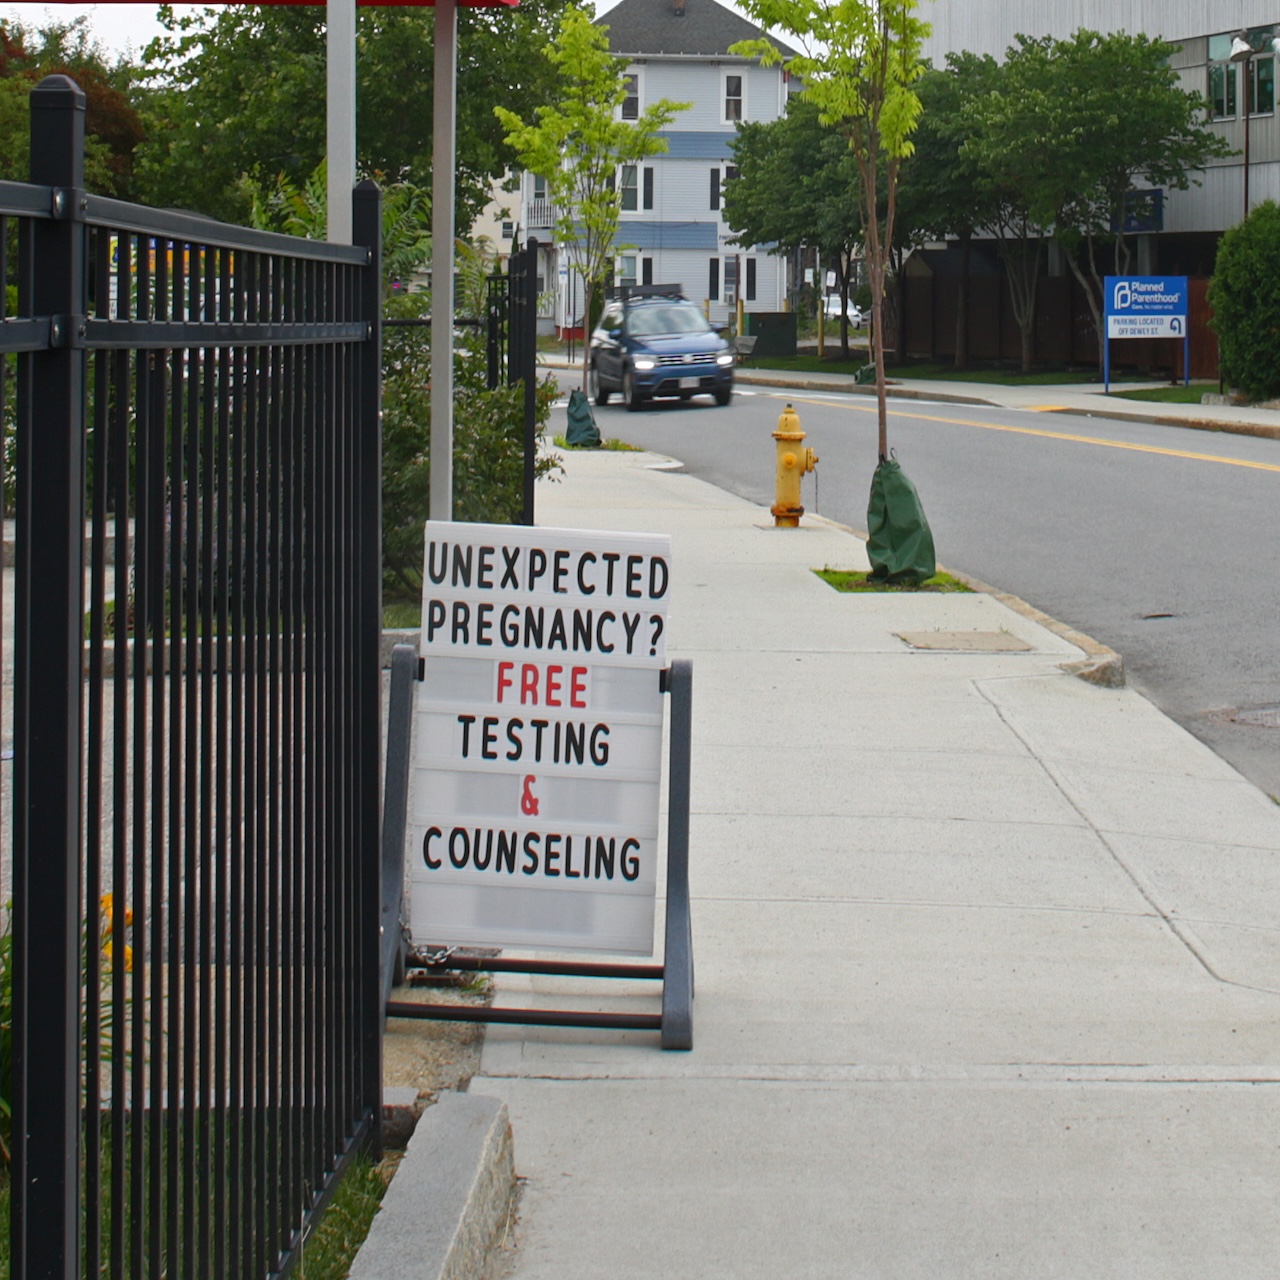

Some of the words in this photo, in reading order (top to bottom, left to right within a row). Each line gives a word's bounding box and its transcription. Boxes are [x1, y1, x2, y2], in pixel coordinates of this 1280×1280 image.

[1131, 281, 1164, 292] Planned
[1113, 317, 1138, 326] PARKING
[1139, 317, 1164, 326] LOCATED
[1118, 327, 1129, 335] OFF
[428, 541, 669, 599] UNEXPECTED
[427, 599, 665, 656] PREGNANCY?
[496, 661, 588, 708] FREE
[457, 714, 610, 766] TESTING
[520, 774, 539, 816] &
[422, 826, 641, 881] COUNSELING
